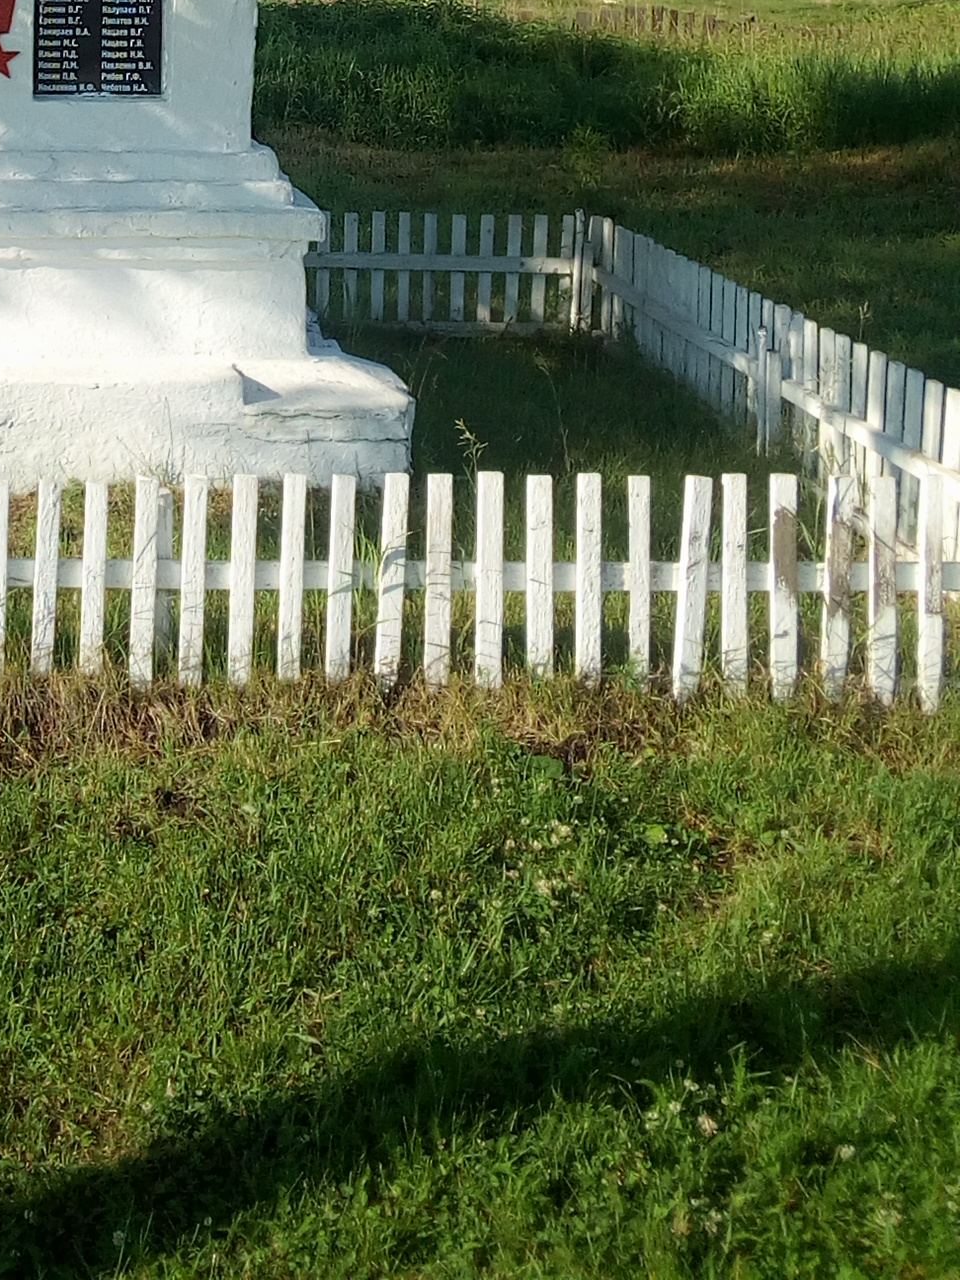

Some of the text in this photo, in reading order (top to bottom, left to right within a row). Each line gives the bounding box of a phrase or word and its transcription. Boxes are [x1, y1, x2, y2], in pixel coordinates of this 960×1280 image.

[138, 5, 154, 14] П.Т.
[67, 16, 83, 25] В.Г.
[75, 27, 91, 36] В.А.
[130, 27, 145, 37] В.Г.
[38, 38, 61, 47] Ильин
[38, 49, 79, 59] Ильин П.Д.
[101, 72, 142, 81] Рябов Г.Ф.
